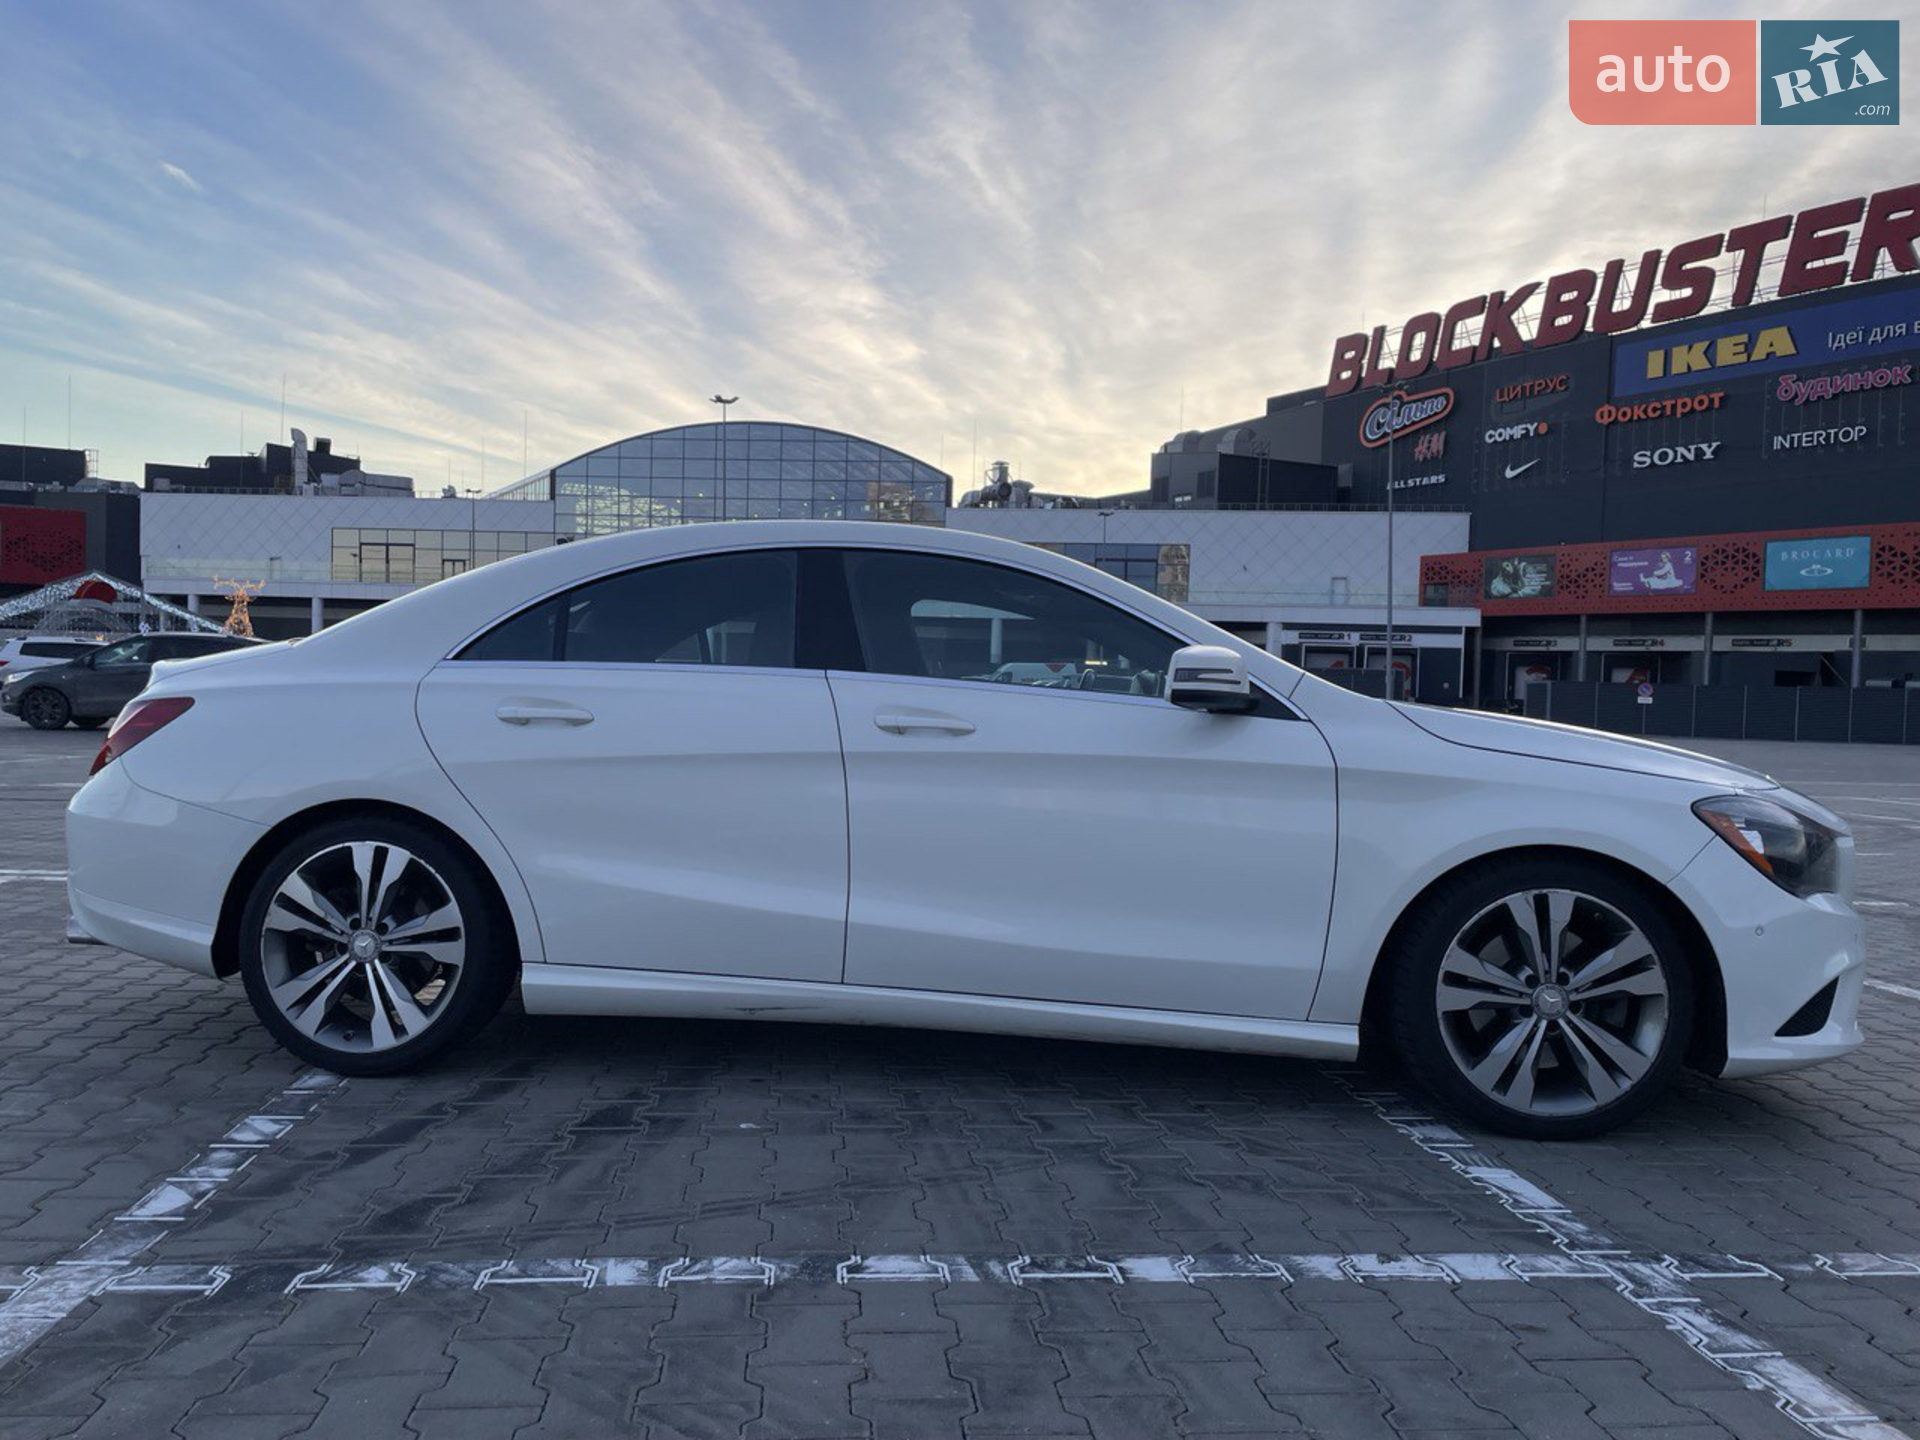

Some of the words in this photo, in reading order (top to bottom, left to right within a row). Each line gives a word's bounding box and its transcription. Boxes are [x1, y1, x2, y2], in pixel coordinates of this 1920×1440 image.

[1325, 182, 1920, 397] BLOCKBUSTER
[1827, 326, 1865, 351] Ідеї
[1867, 323, 1907, 345] для
[1646, 325, 1798, 379] IKEA
[1496, 375, 1568, 402] ЦИТРУС
[1776, 364, 1912, 405] будинок
[1594, 391, 1725, 425] Фокстрот
[1484, 422, 1538, 443] COMFY
[1773, 425, 1867, 450] INTERTOP
[1632, 441, 1721, 469] SONY
[1781, 547, 1855, 561] BROCARD
